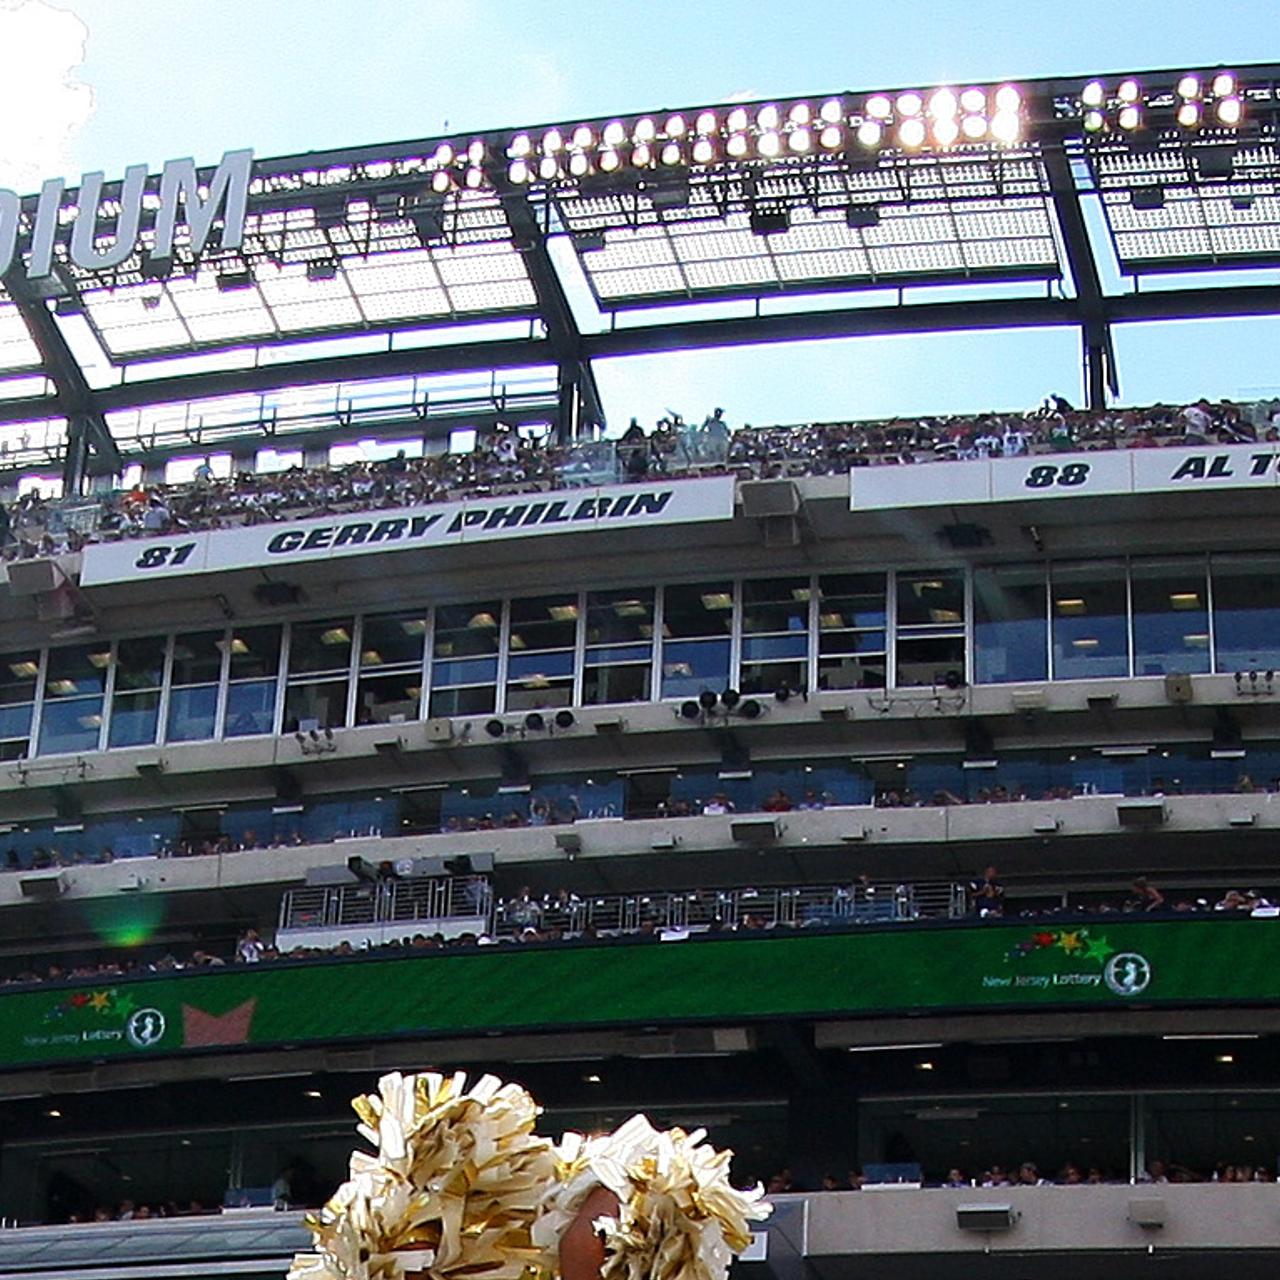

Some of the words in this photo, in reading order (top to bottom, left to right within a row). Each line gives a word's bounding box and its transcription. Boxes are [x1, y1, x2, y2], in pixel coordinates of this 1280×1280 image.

[1025, 463, 1090, 488] 88
[1171, 455, 1234, 480] AL
[135, 542, 196, 569] 81
[266, 513, 445, 554] GERRY
[446, 490, 675, 533] PHILBIN
[982, 976, 1012, 987] New
[1052, 974, 1102, 987] Lottery
